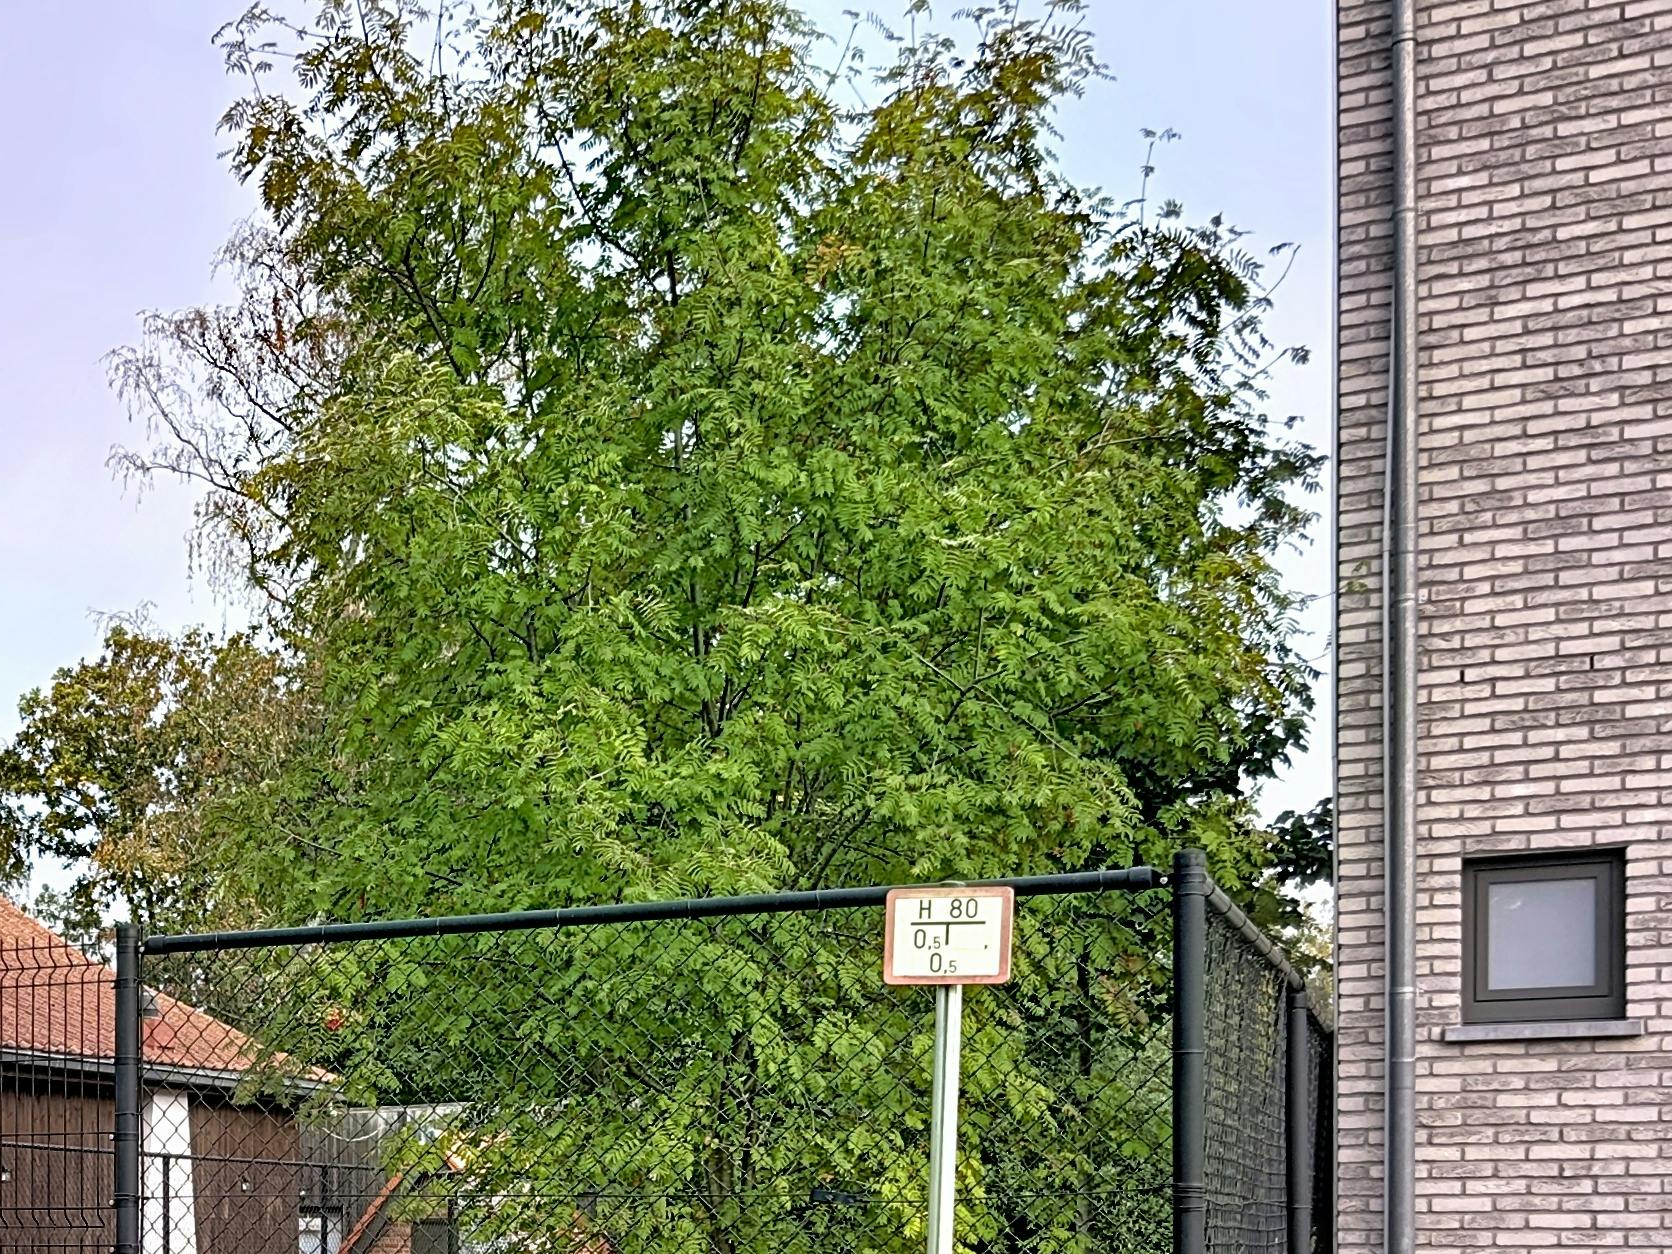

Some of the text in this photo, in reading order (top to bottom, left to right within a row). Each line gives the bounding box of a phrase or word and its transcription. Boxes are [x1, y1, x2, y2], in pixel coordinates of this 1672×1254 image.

[919, 898, 978, 919] H 80
[914, 928, 941, 951] 0,5
[929, 952, 957, 975] 0,5
